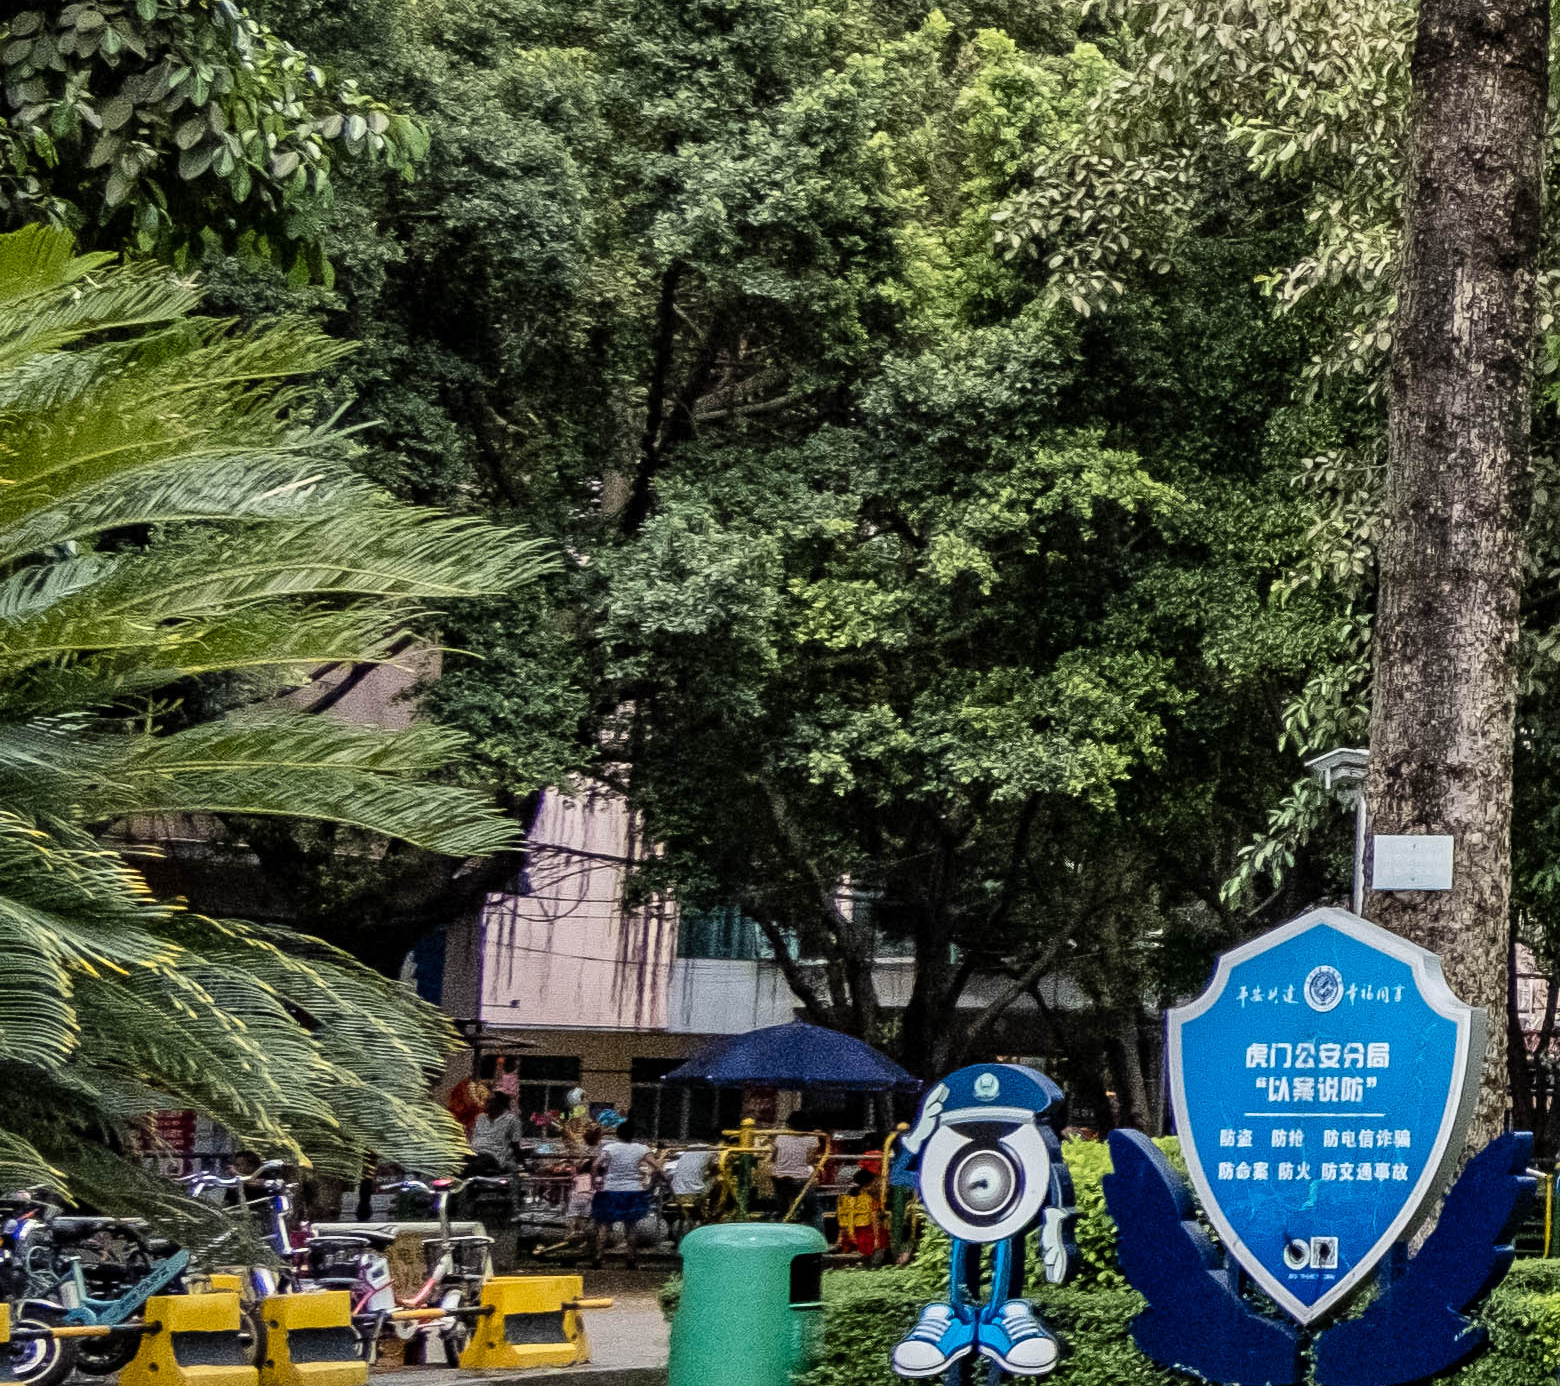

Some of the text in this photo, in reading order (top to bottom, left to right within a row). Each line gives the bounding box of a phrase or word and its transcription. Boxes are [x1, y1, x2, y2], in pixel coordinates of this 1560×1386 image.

[1246, 1042, 1390, 1069] 虎门公安分局
[1220, 1129, 1253, 1147] 防盗
[1323, 1129, 1410, 1148] 防电信诈骗
[1218, 1161, 1408, 1181] 防命案 防火 防交通事故
